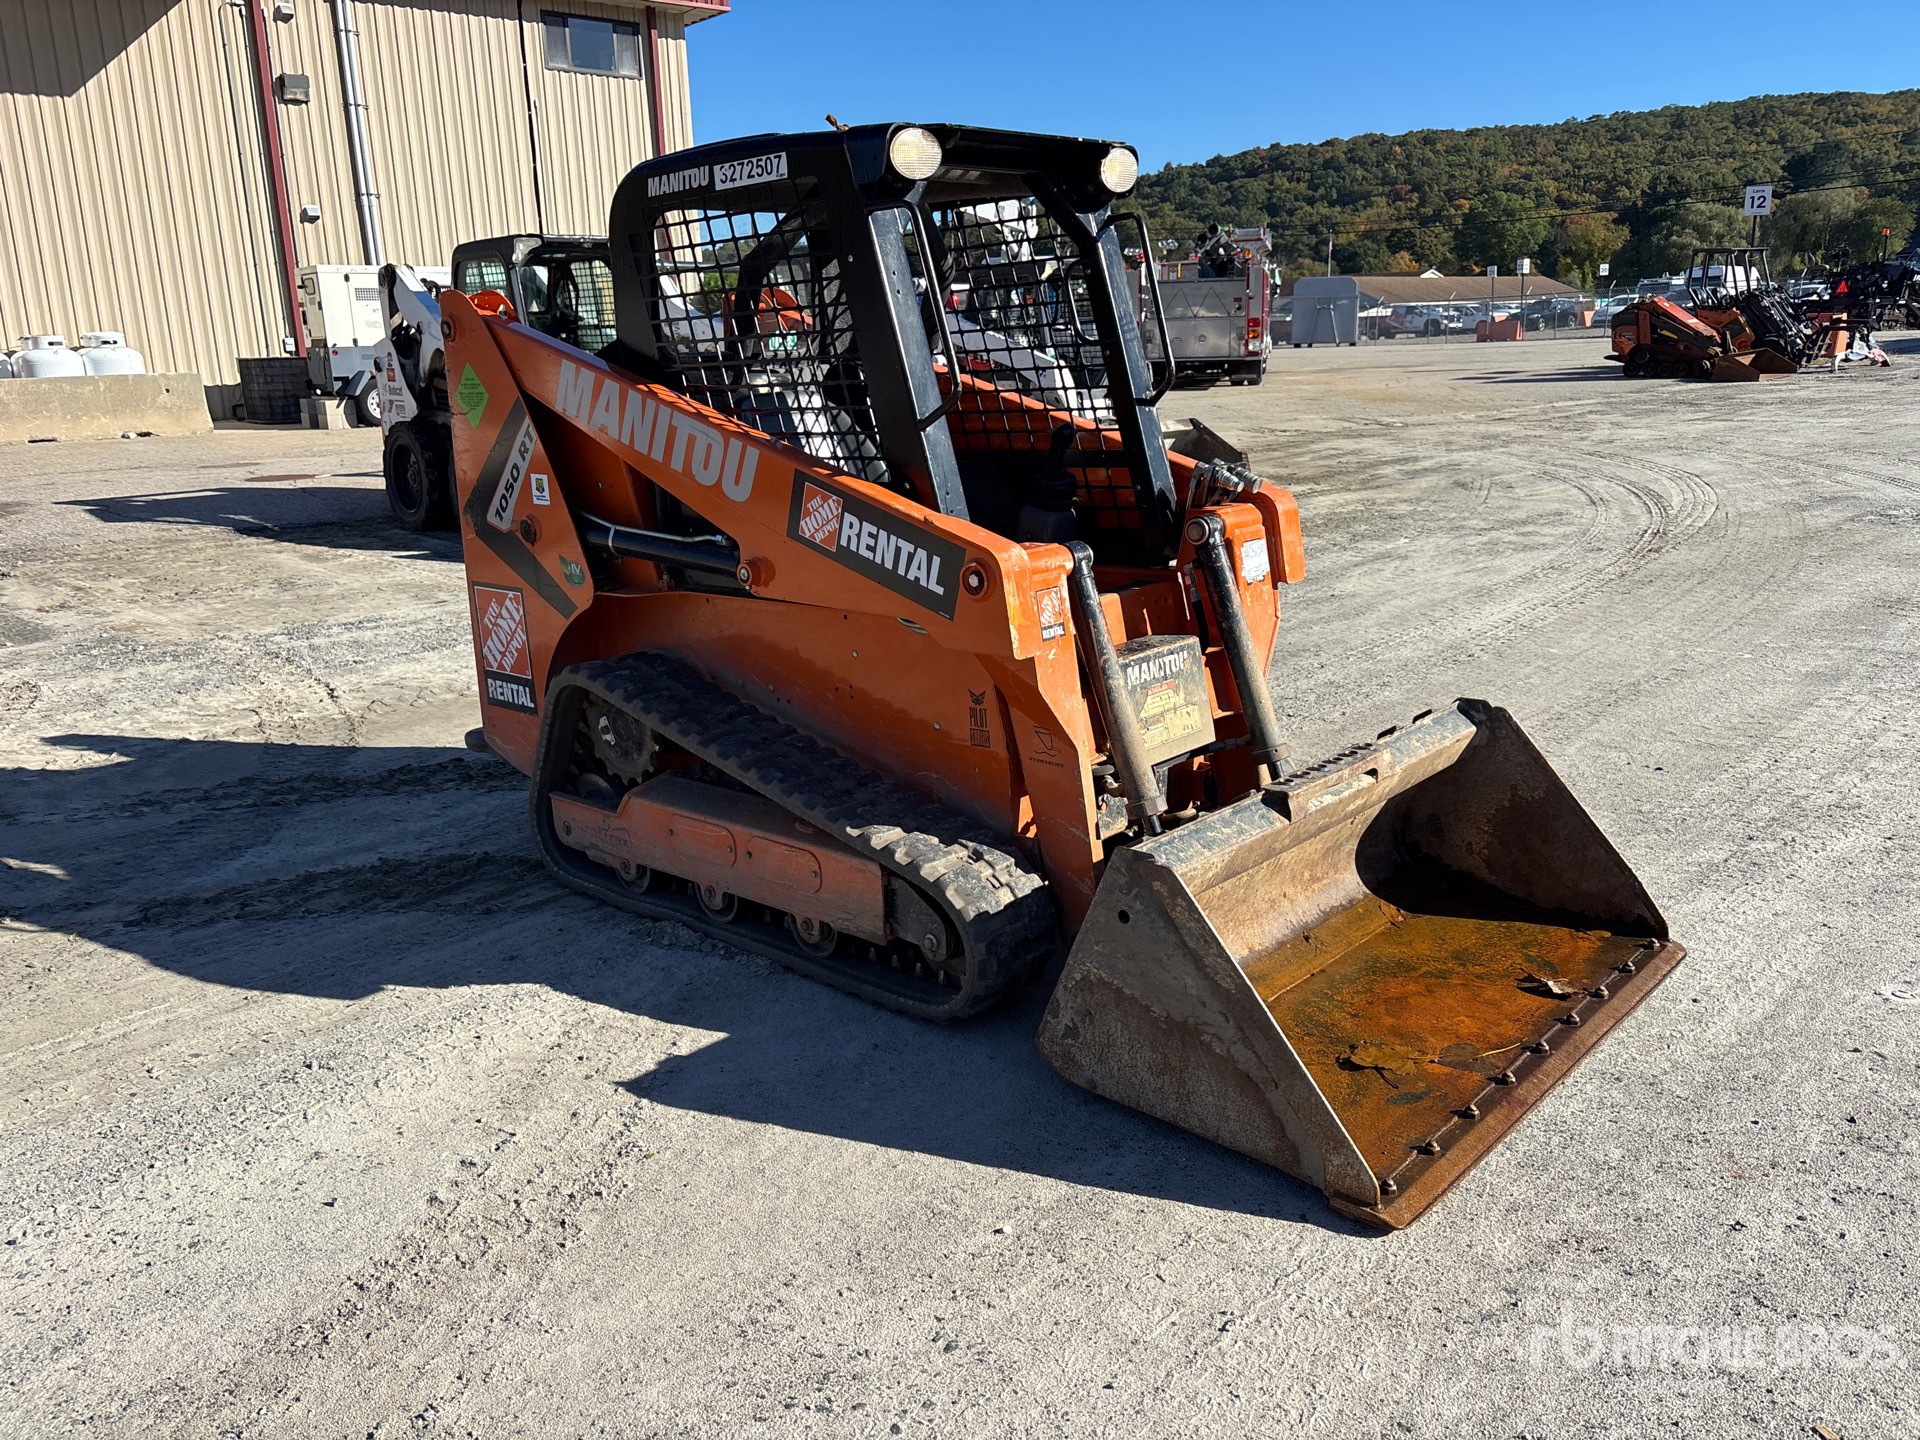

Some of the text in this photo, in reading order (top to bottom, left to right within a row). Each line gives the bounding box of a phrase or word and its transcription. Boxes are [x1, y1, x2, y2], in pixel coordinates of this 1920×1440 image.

[648, 165, 709, 197] MANITOU
[720, 154, 782, 184] 3272507
[1750, 195, 1767, 209] 12
[555, 359, 760, 502] MANITOU
[495, 423, 534, 522] 1050 RT
[800, 496, 842, 537] HOME
[807, 494, 824, 513] THE
[814, 517, 839, 544] DEPOT
[840, 511, 945, 596] RENTAL
[483, 592, 523, 670] HOME
[487, 678, 535, 708] RENTAL
[969, 706, 988, 728] PILOT
